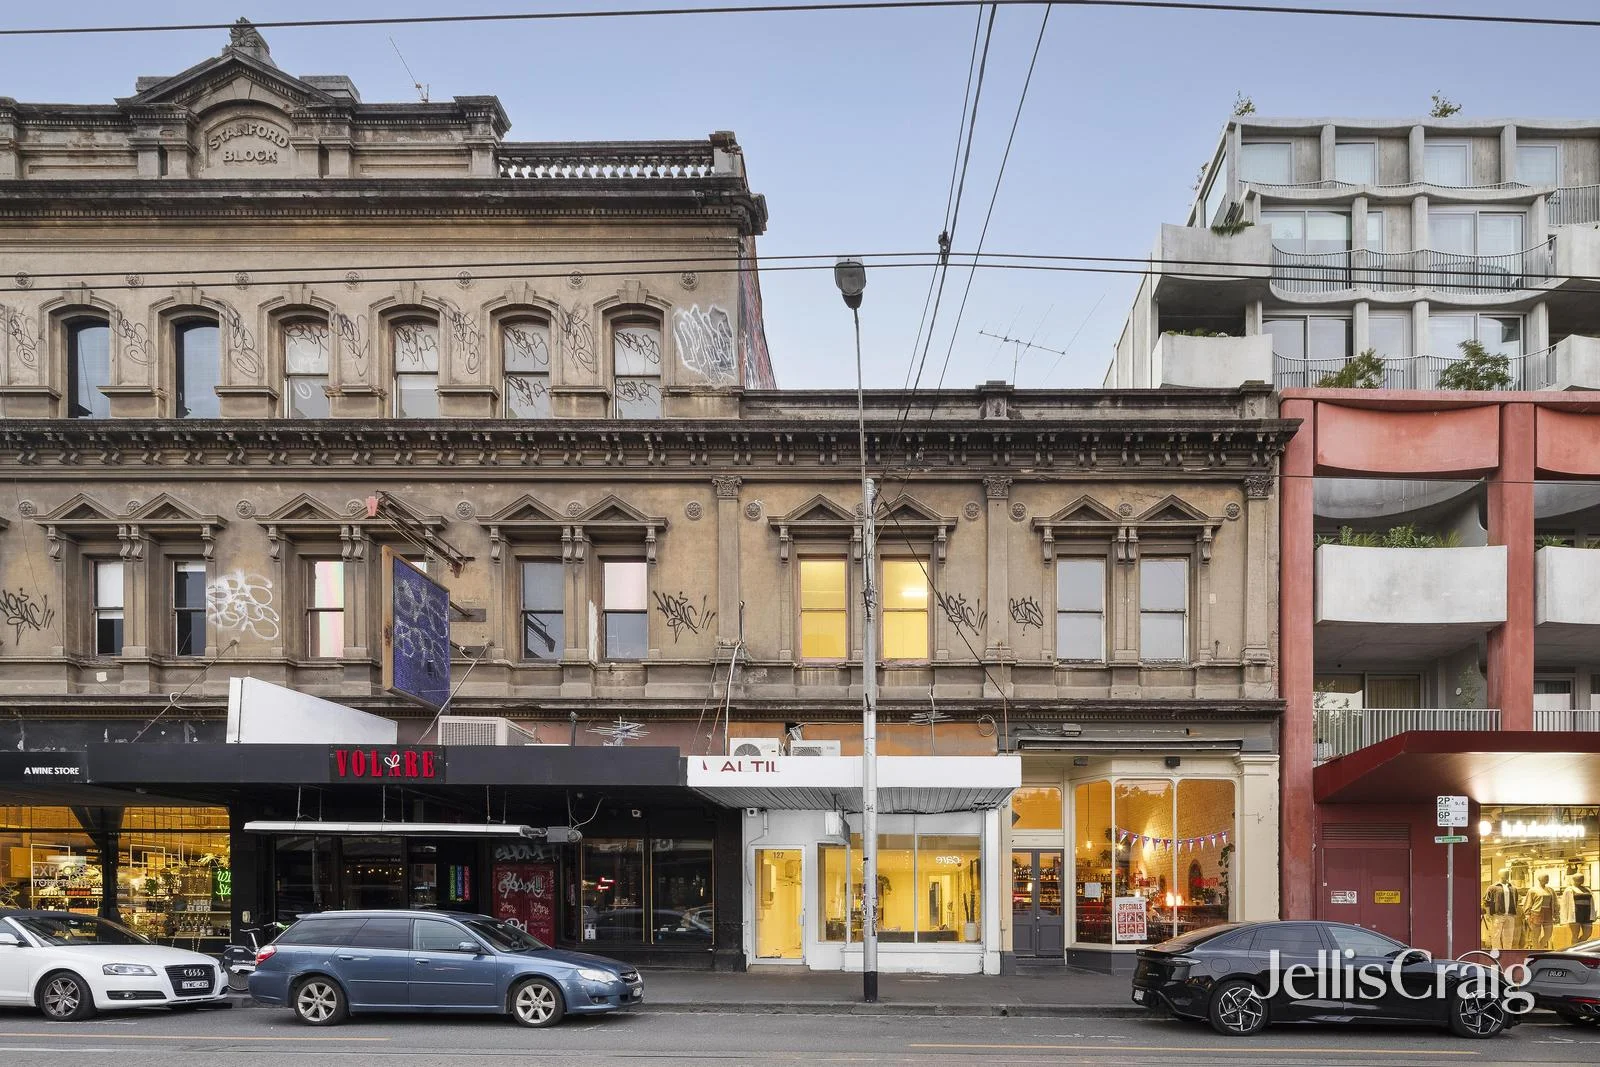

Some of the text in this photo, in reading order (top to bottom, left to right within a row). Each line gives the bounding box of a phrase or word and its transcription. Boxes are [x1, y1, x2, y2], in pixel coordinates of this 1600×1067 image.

[208, 122, 289, 150] STANFORD
[223, 150, 278, 163] BLOCK
[336, 750, 434, 777] VOLARE
[24, 766, 80, 775] A WINE STORE
[1438, 797, 1451, 805] 2P
[1438, 811, 1451, 820] 6P
[773, 851, 785, 859] 127
[1118, 903, 1143, 911] SPECIALS
